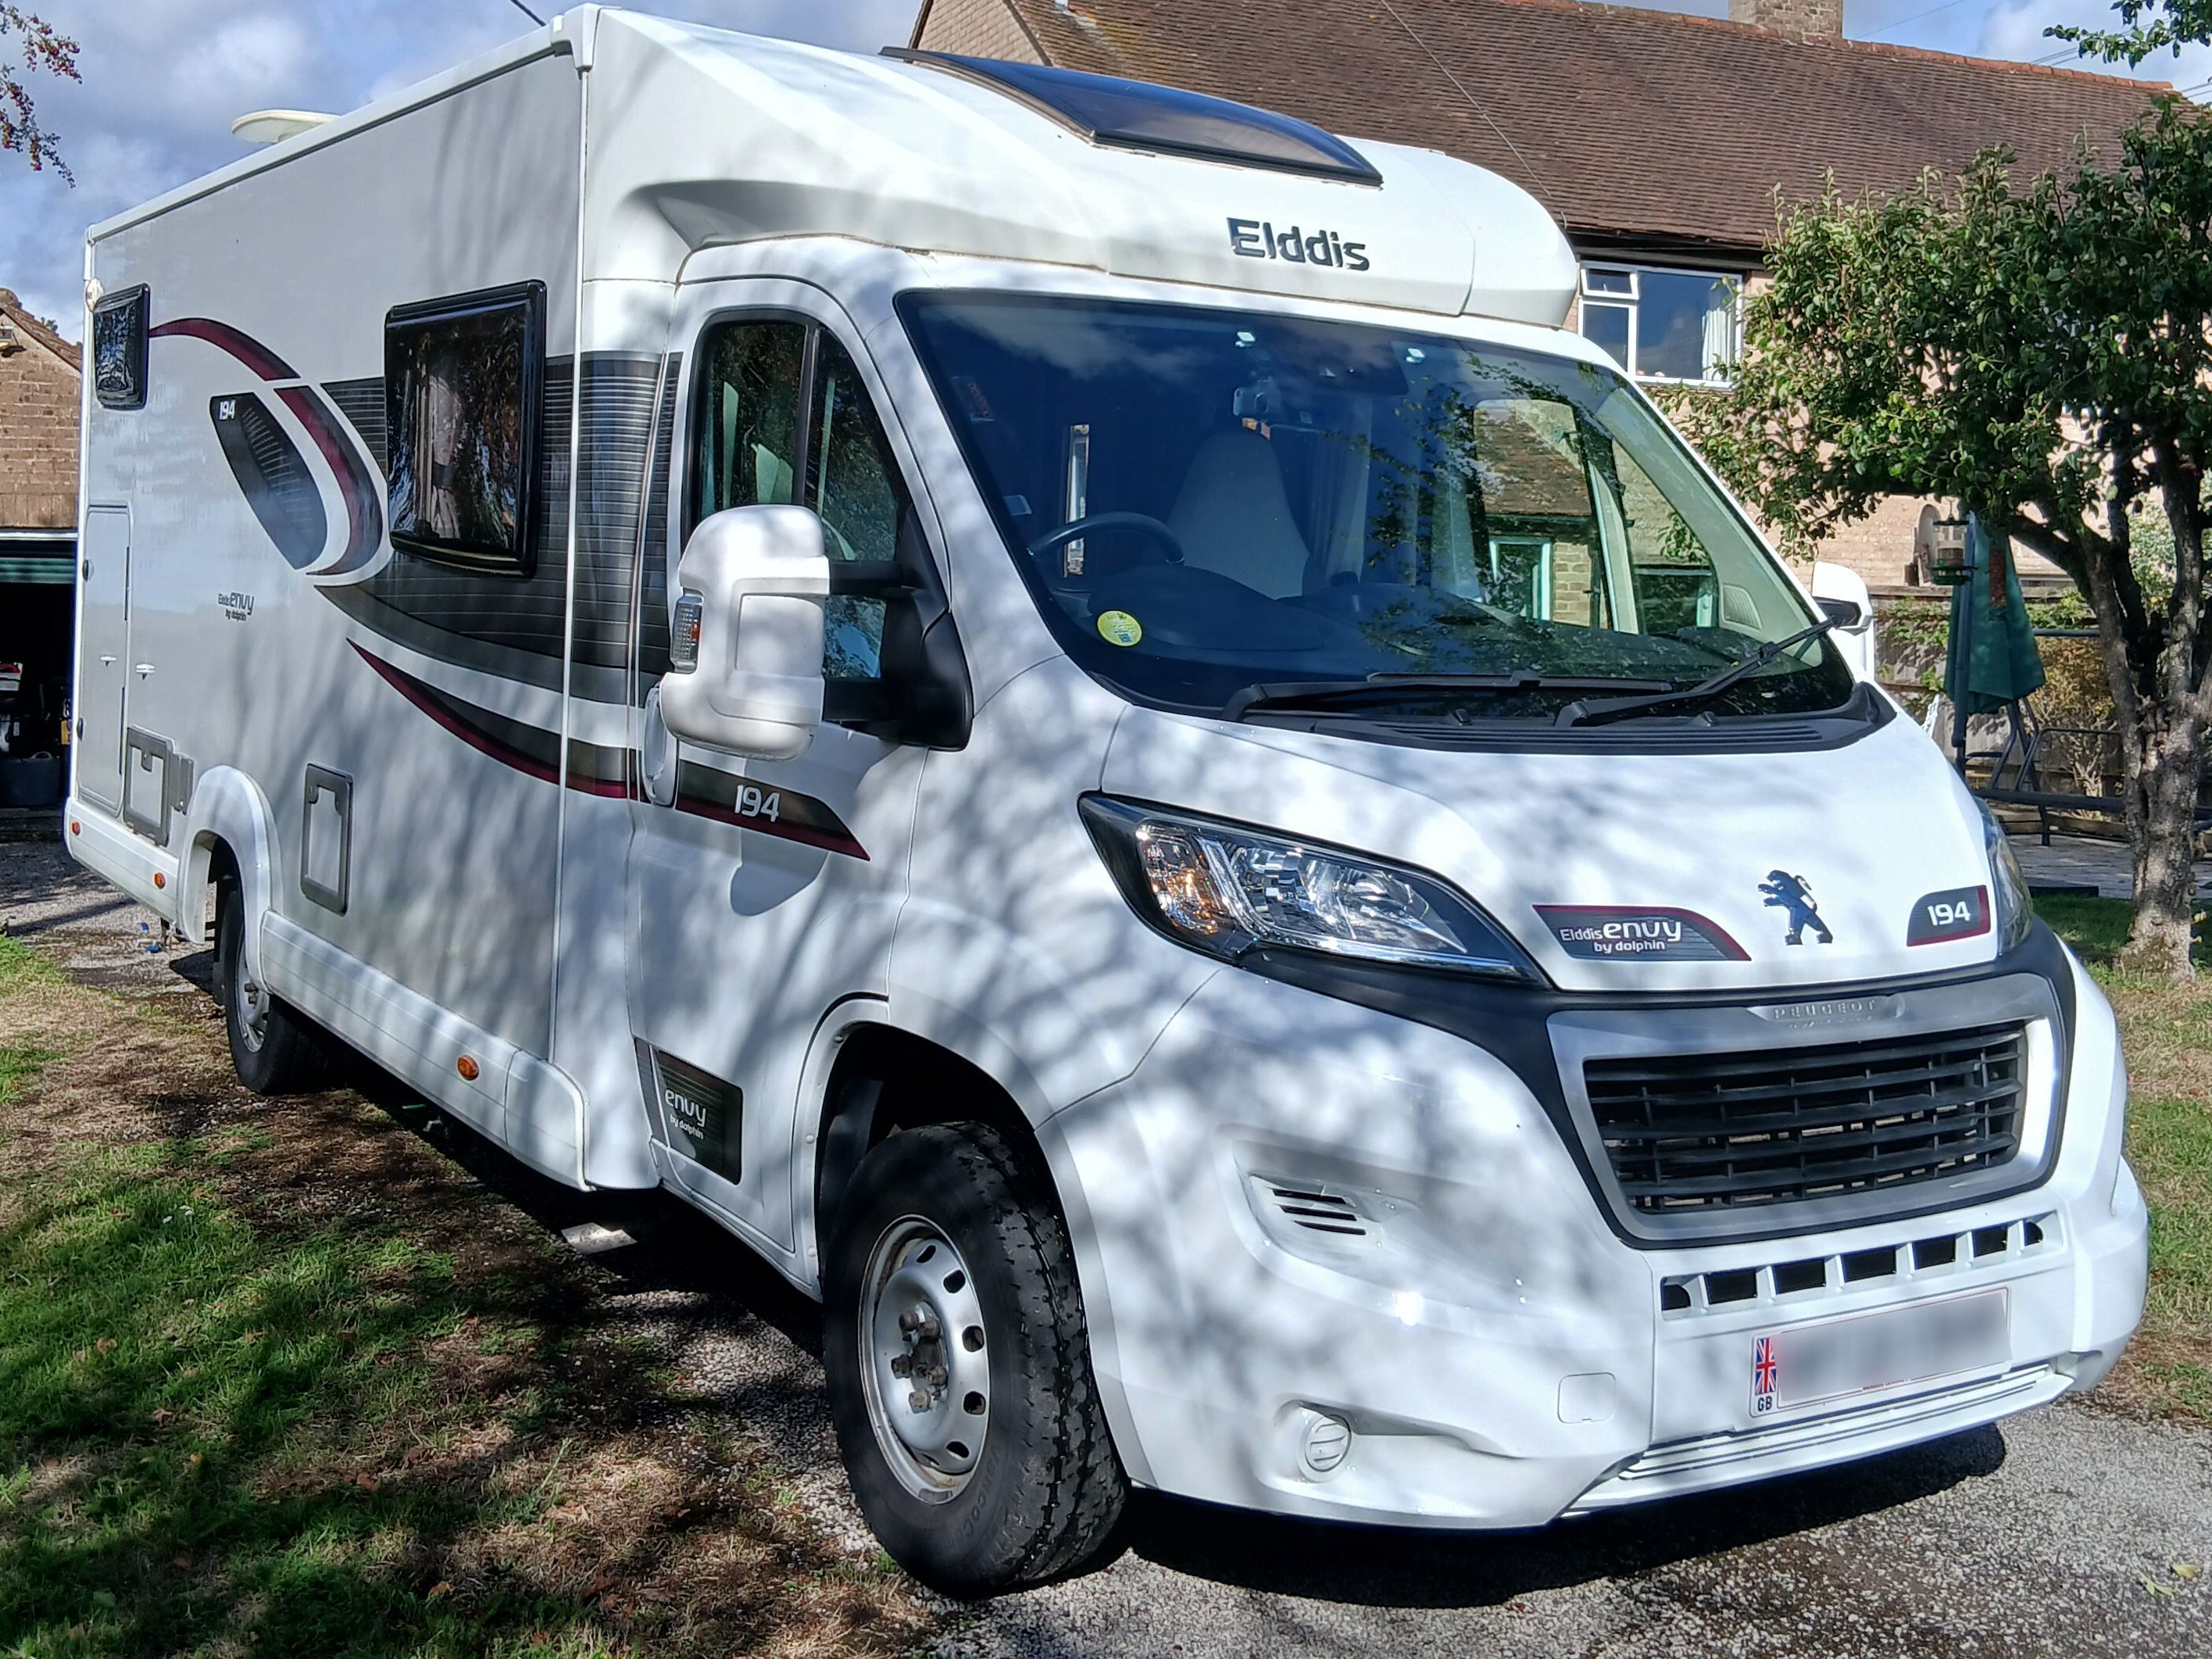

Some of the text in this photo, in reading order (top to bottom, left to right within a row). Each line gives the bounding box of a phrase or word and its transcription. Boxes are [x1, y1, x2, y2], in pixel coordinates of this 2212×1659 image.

[1226, 216, 1370, 272] Elddis
[219, 399, 236, 420] 194
[734, 784, 781, 823] 194
[1926, 900, 1971, 926] 194
[1559, 921, 1682, 942] Elddis envy
[1593, 939, 1666, 954] by dolphin
[1774, 999, 1876, 1020] PEUGEOT
[664, 1089, 707, 1128] envy
[670, 1114, 679, 1128] by
[1757, 1396, 1773, 1412] GB
